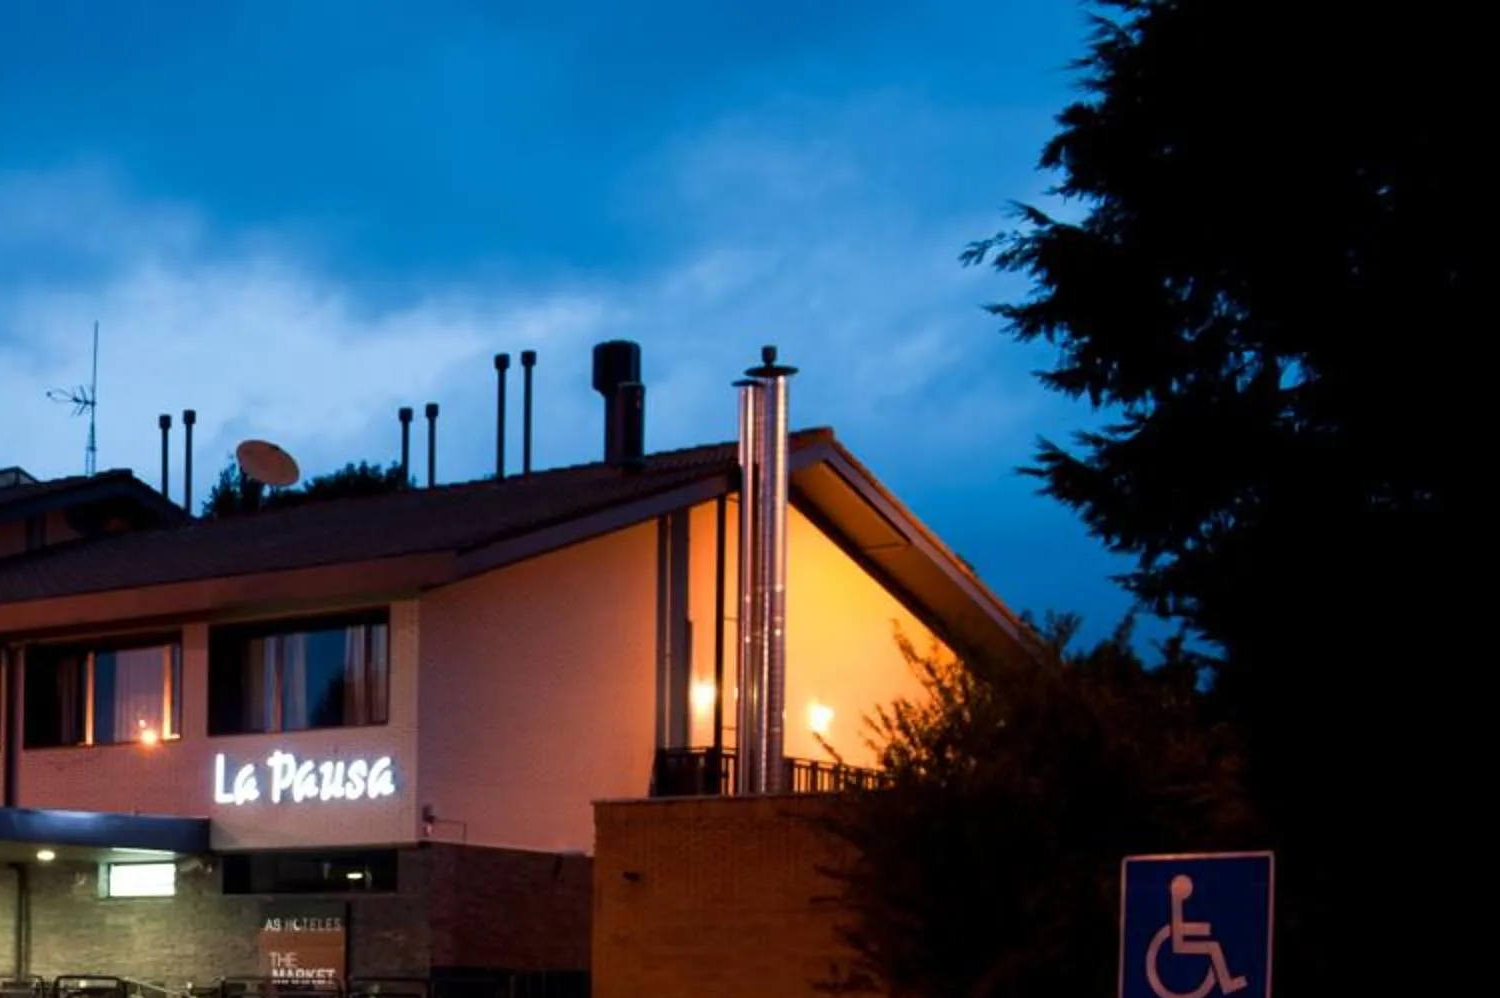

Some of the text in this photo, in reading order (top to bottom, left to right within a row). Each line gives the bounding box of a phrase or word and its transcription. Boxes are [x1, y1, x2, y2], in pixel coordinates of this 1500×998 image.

[214, 749, 396, 806] La Pausa
[264, 917, 281, 932] AS
[269, 951, 297, 969] THE
[271, 967, 336, 985] MARKET
